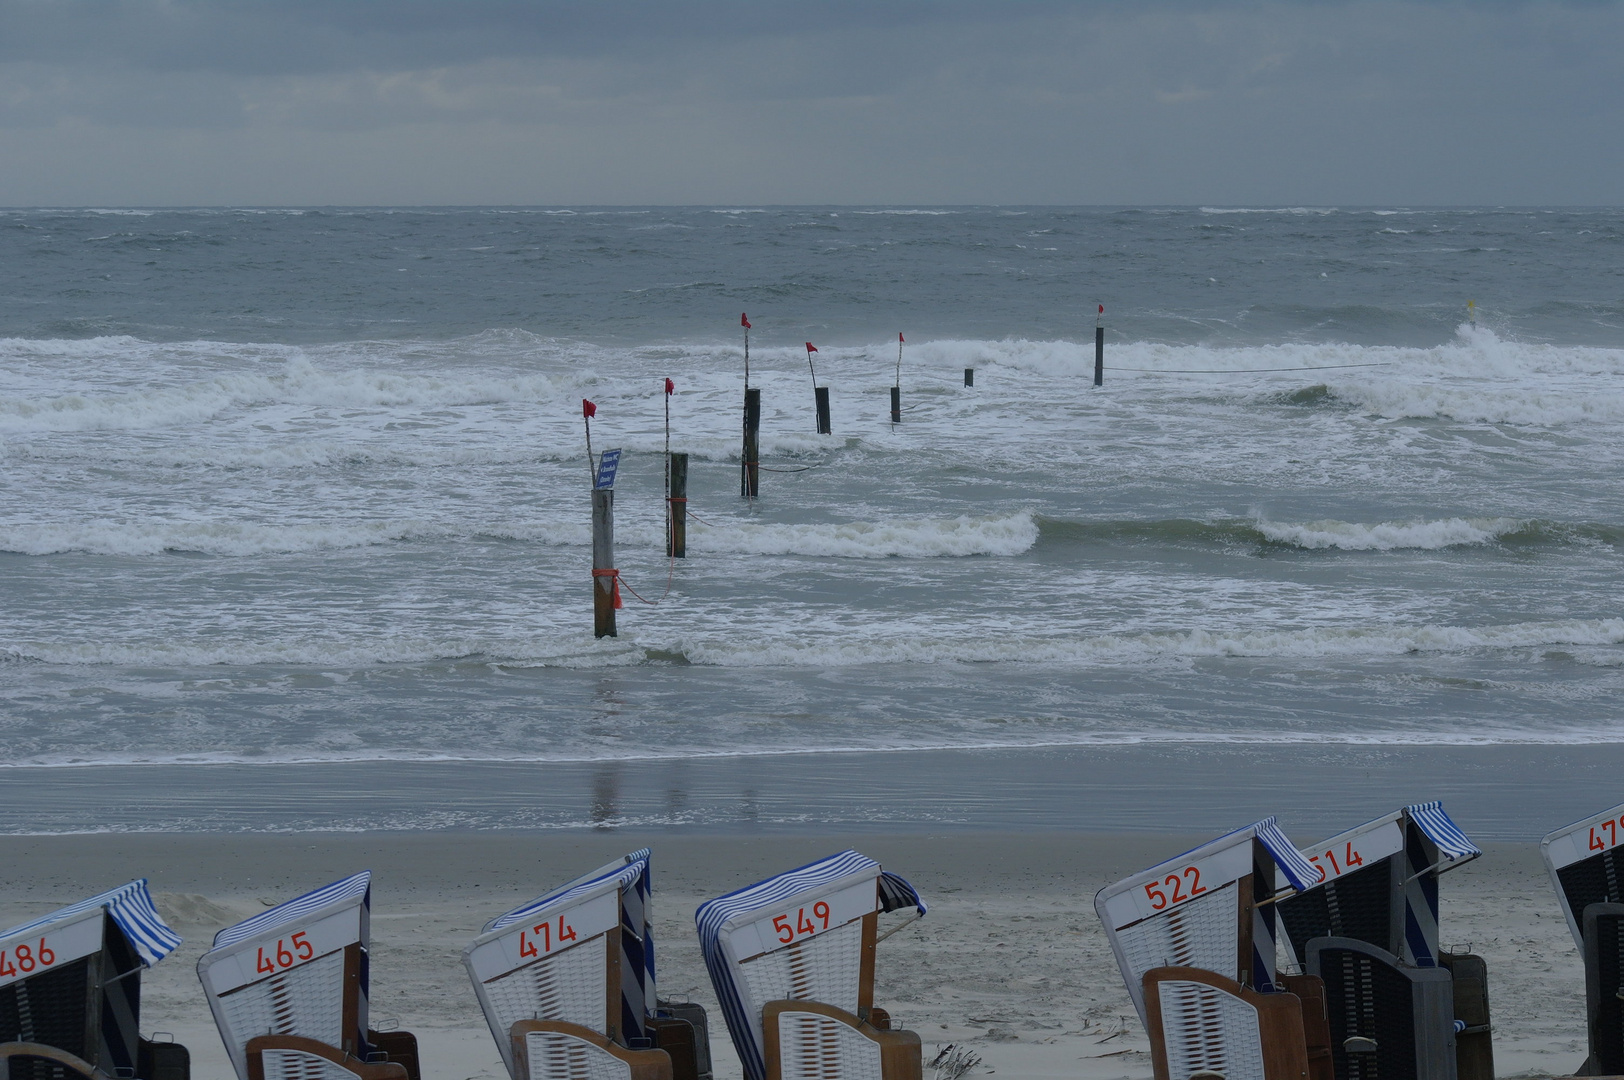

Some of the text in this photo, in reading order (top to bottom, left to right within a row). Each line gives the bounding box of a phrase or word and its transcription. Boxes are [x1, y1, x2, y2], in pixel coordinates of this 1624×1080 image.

[1145, 866, 1207, 910] 522
[520, 915, 577, 958] 474
[773, 901, 830, 944] 549
[0, 937, 55, 977] 486
[256, 931, 314, 974] 465
